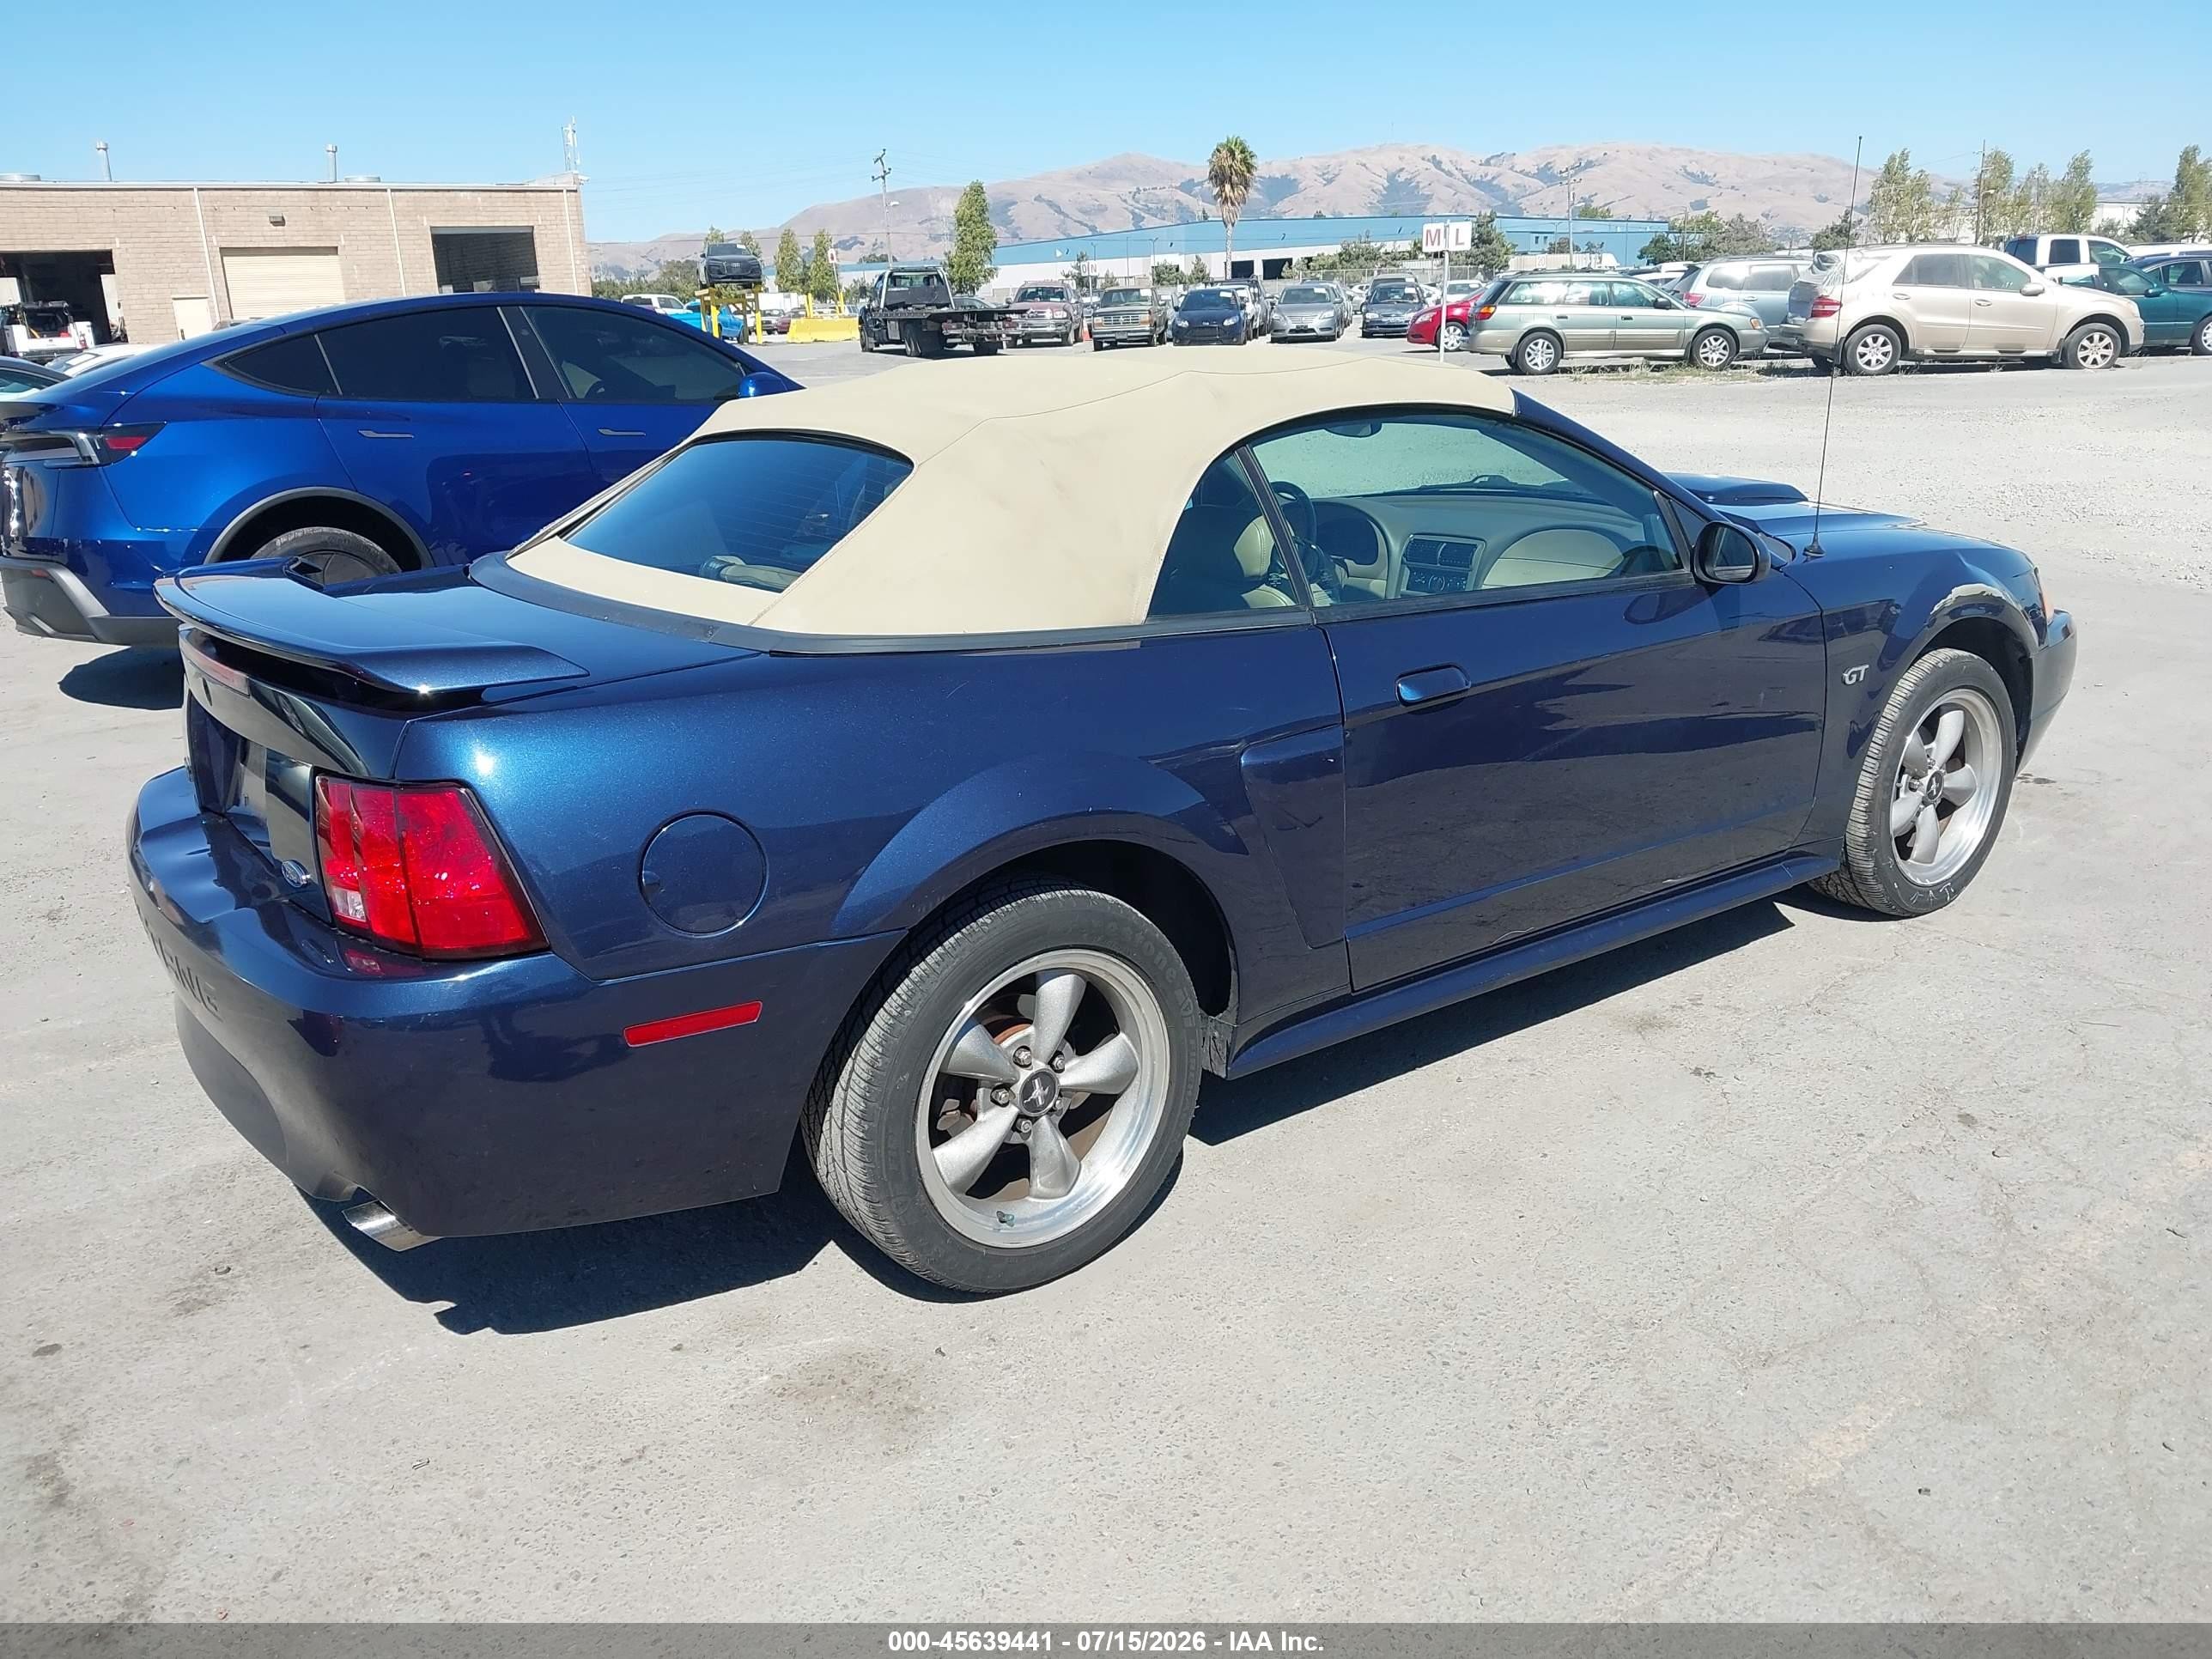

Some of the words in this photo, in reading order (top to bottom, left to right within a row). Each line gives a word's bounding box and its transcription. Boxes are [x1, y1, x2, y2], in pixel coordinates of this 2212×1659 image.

[1425, 228, 1441, 246] M
[1455, 228, 1465, 246] L
[1091, 264, 1097, 273] N
[1843, 665, 1869, 685] GT
